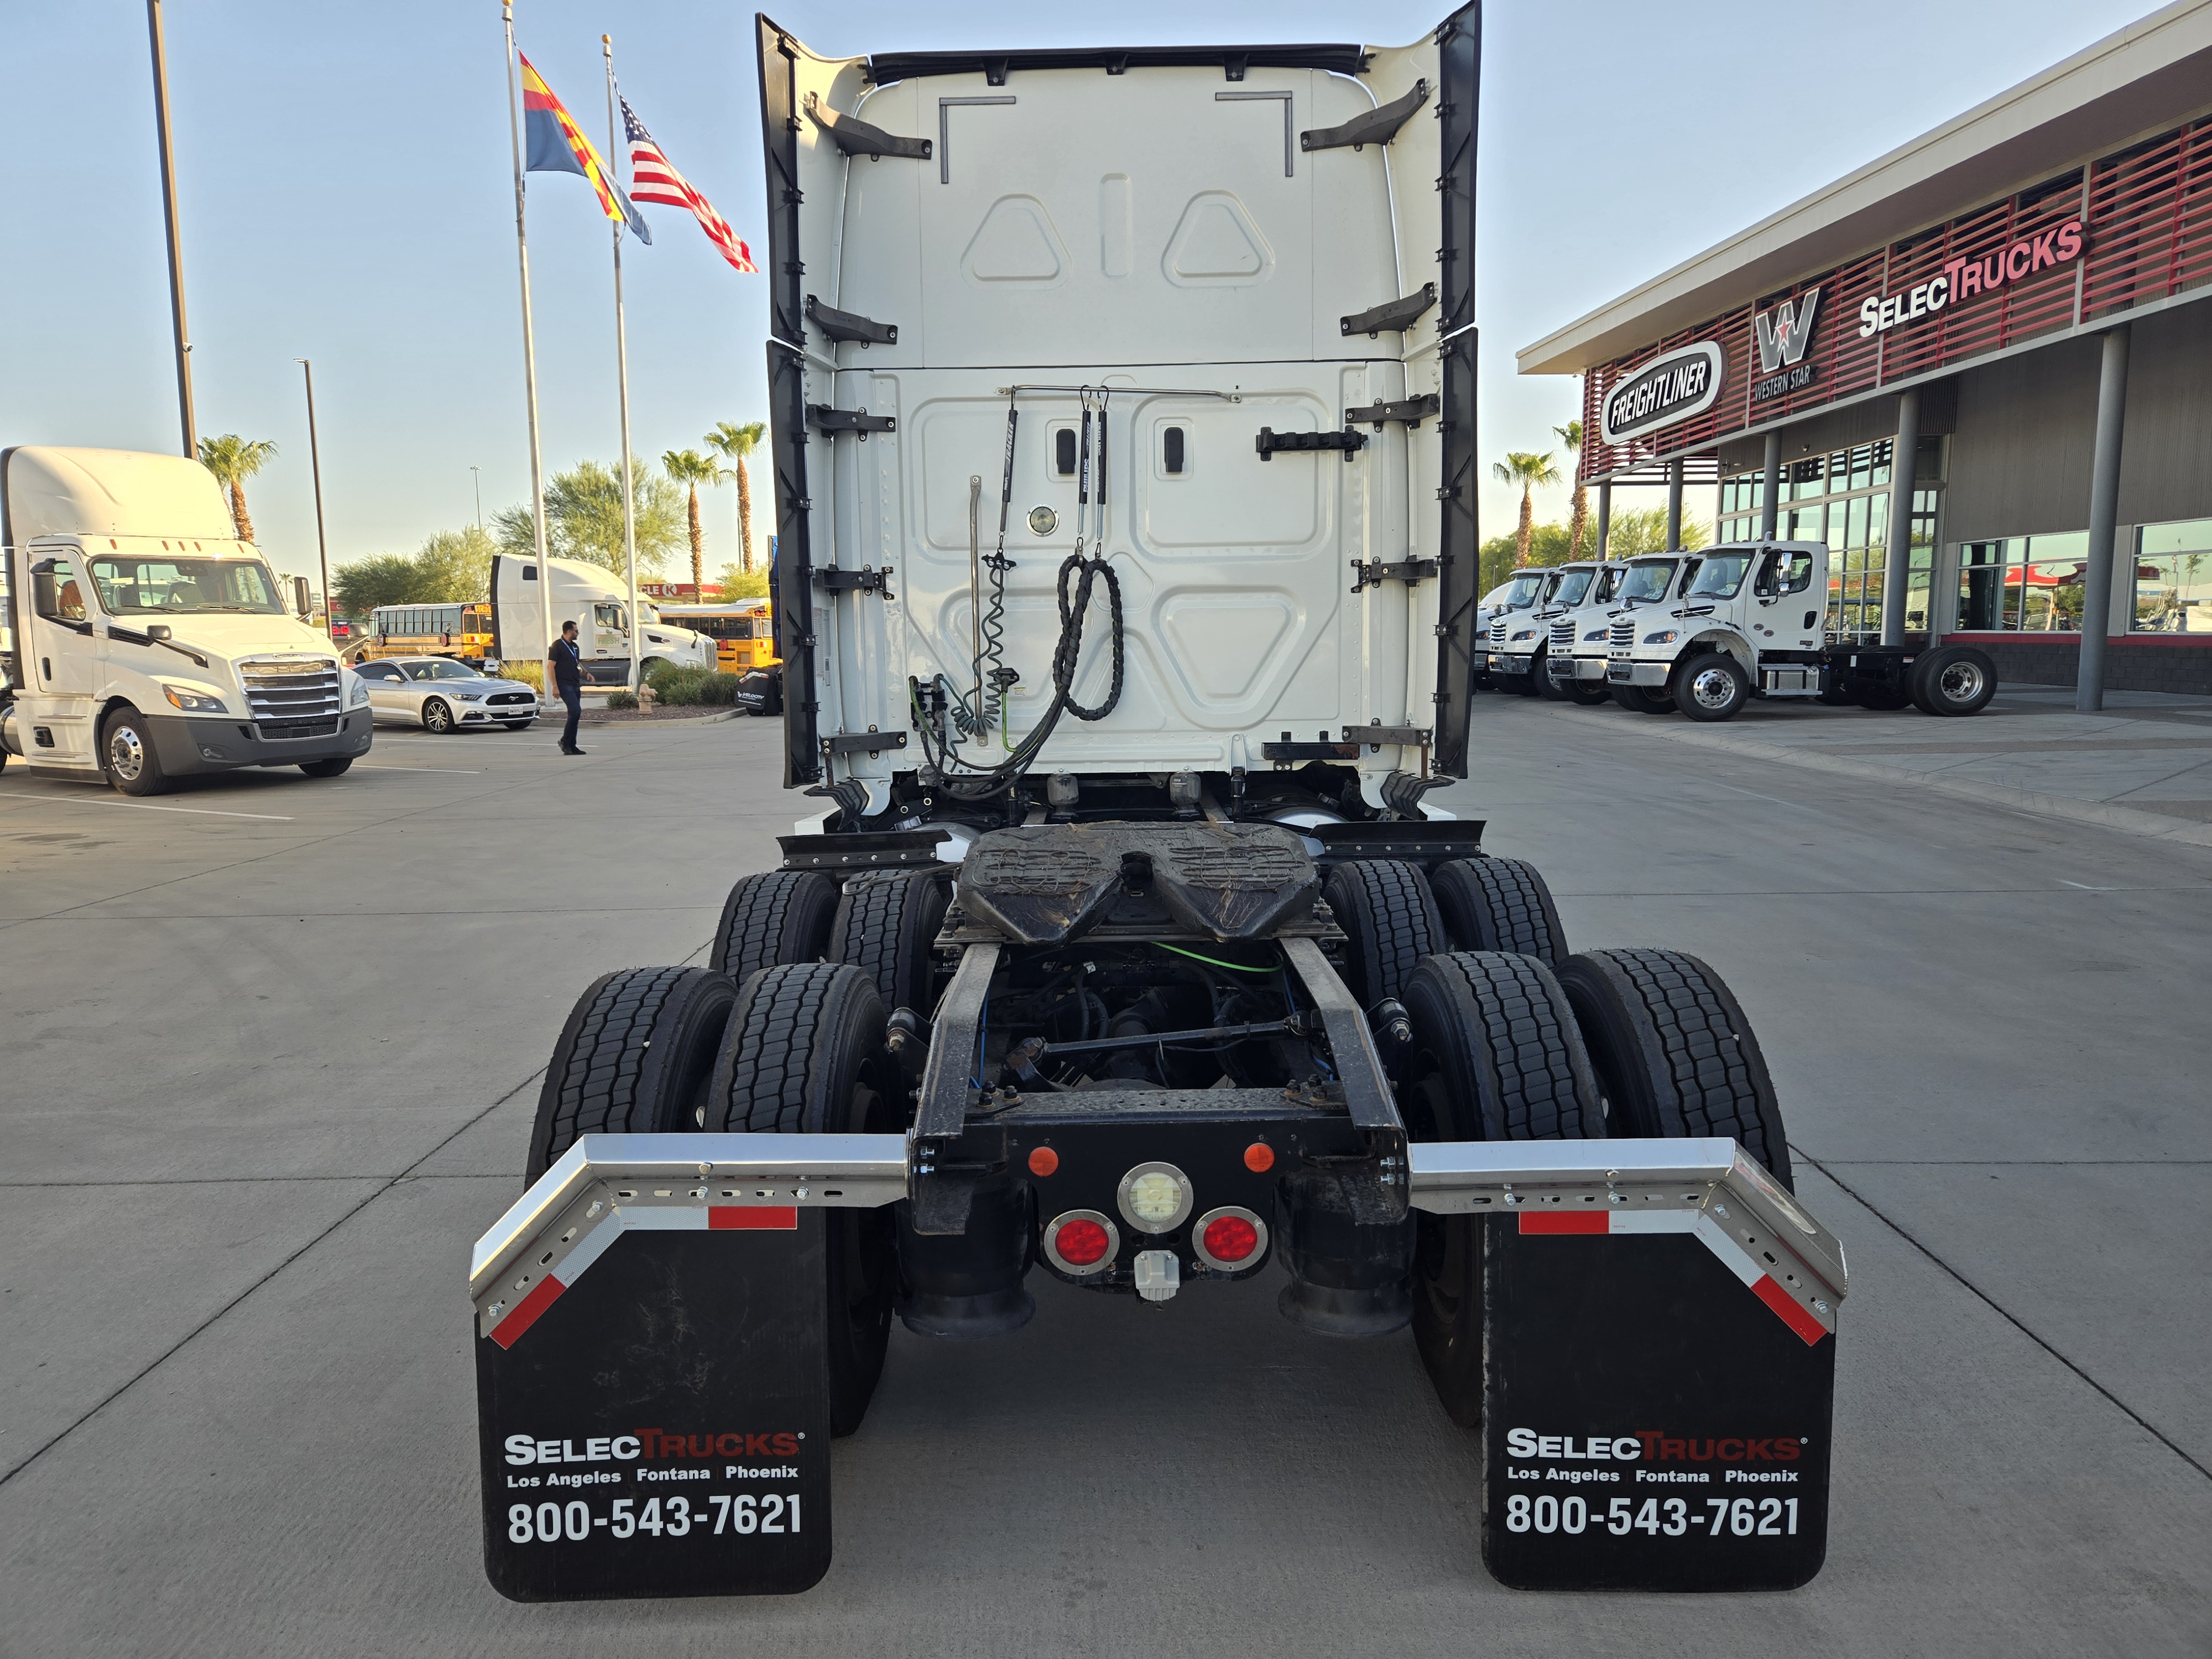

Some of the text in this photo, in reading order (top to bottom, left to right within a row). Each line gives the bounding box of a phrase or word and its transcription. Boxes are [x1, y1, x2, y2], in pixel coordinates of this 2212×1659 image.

[1859, 221, 2082, 338] SELECTRUCKS
[1610, 361, 1707, 429] FREIGHTLINER
[1755, 365, 1811, 401] WESTERN STAR
[507, 1465, 798, 1488] Los Angeles Fontana Phoenix
[1508, 1467, 1798, 1483] Los Angeles Fontana Phoenix
[508, 1494, 801, 1543] 800-543-7621
[1506, 1494, 1798, 1536] 800-543-7621
